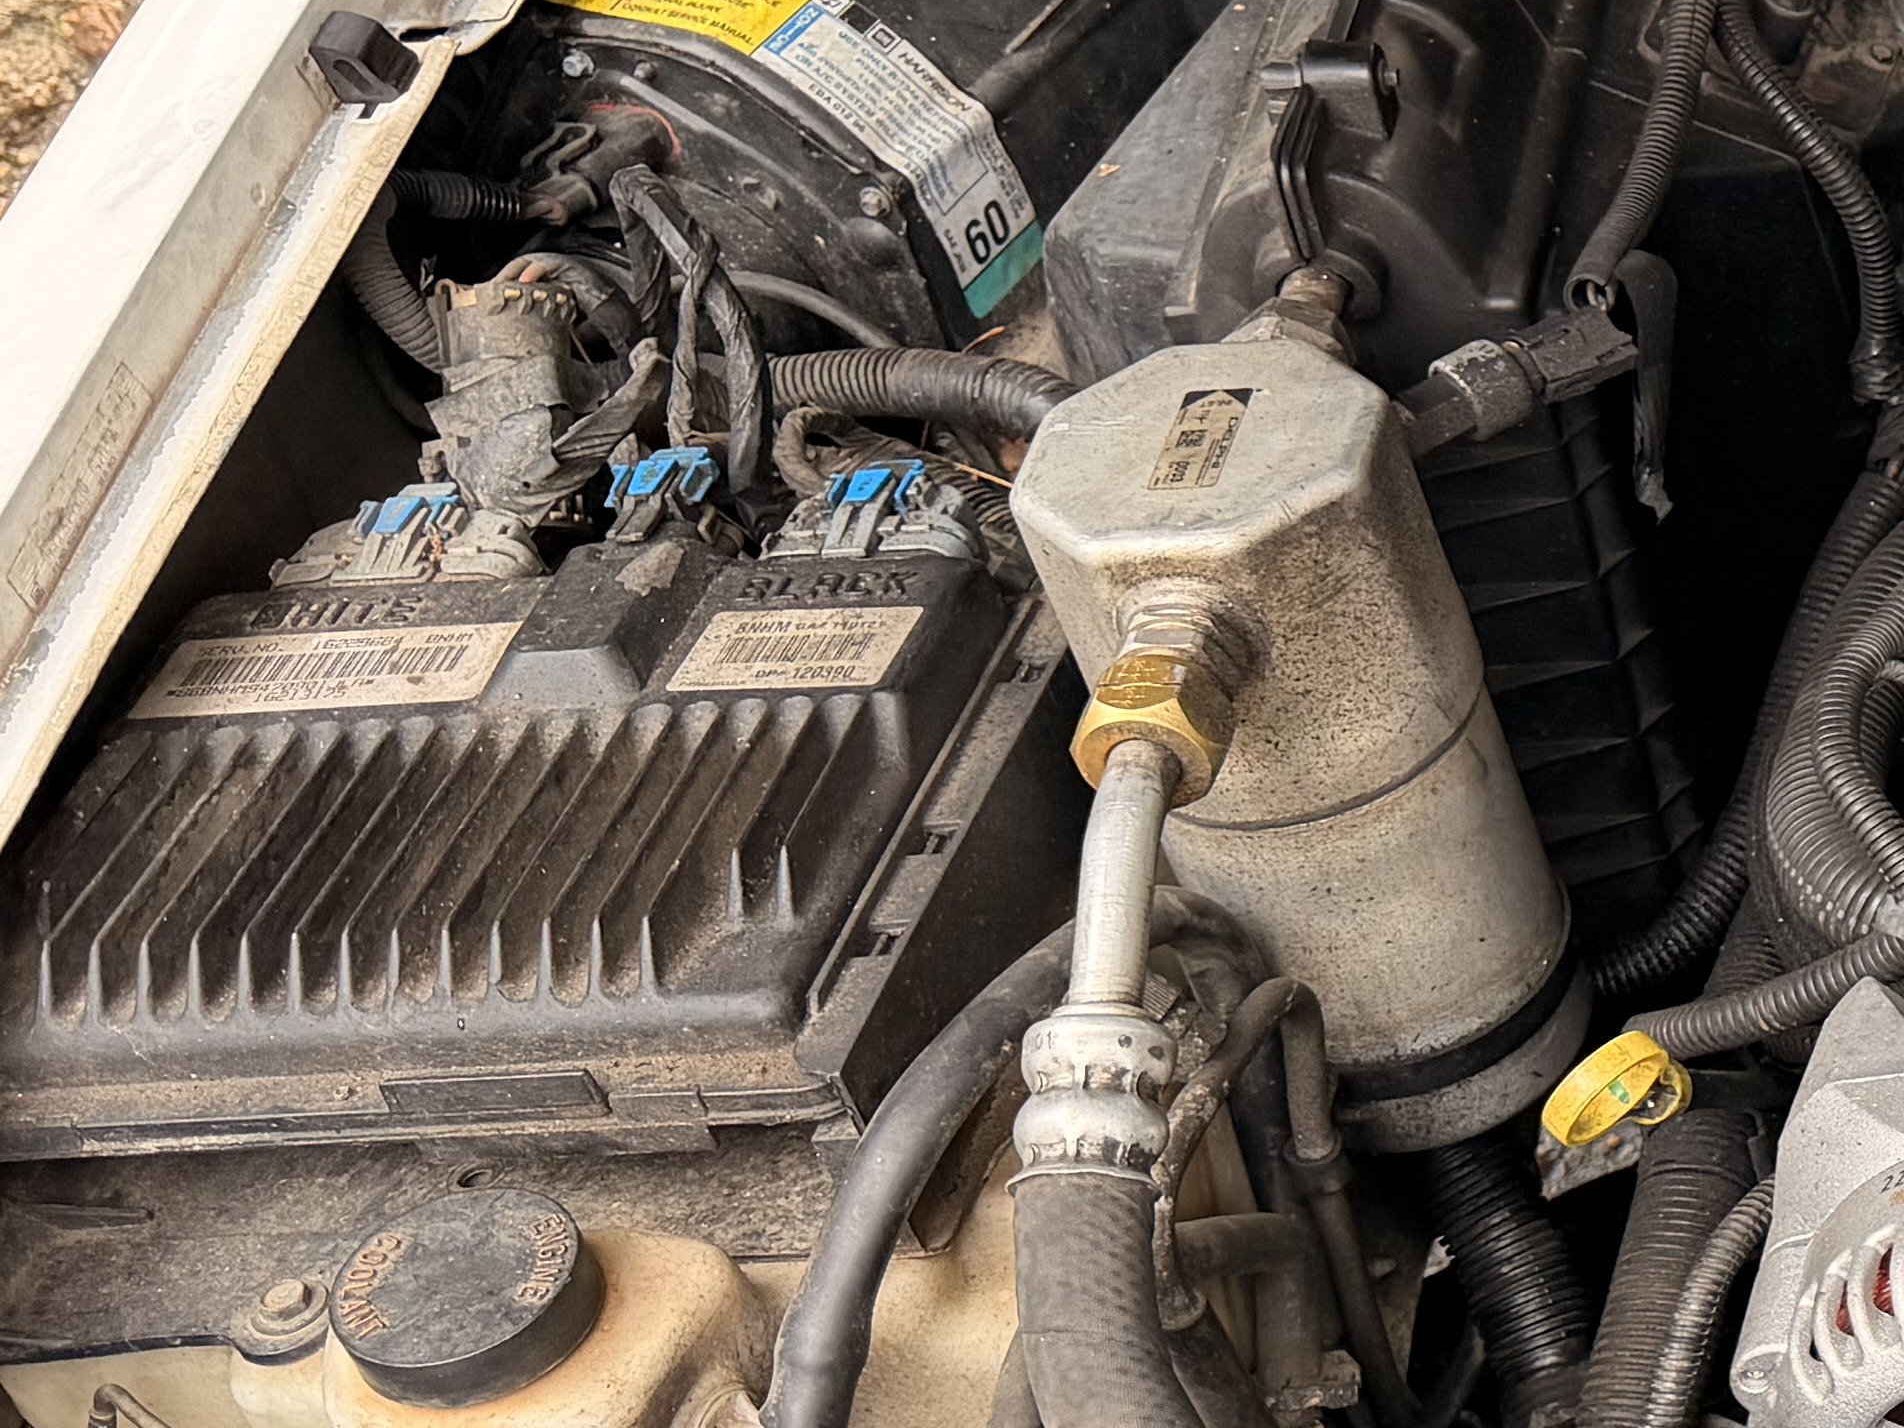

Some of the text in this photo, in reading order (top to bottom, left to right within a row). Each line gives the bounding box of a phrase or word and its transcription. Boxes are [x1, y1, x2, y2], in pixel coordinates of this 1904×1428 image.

[965, 200, 1010, 264] 60
[736, 571, 918, 601] BLACK
[339, 1213, 569, 1340] ENGINE COOLANT
